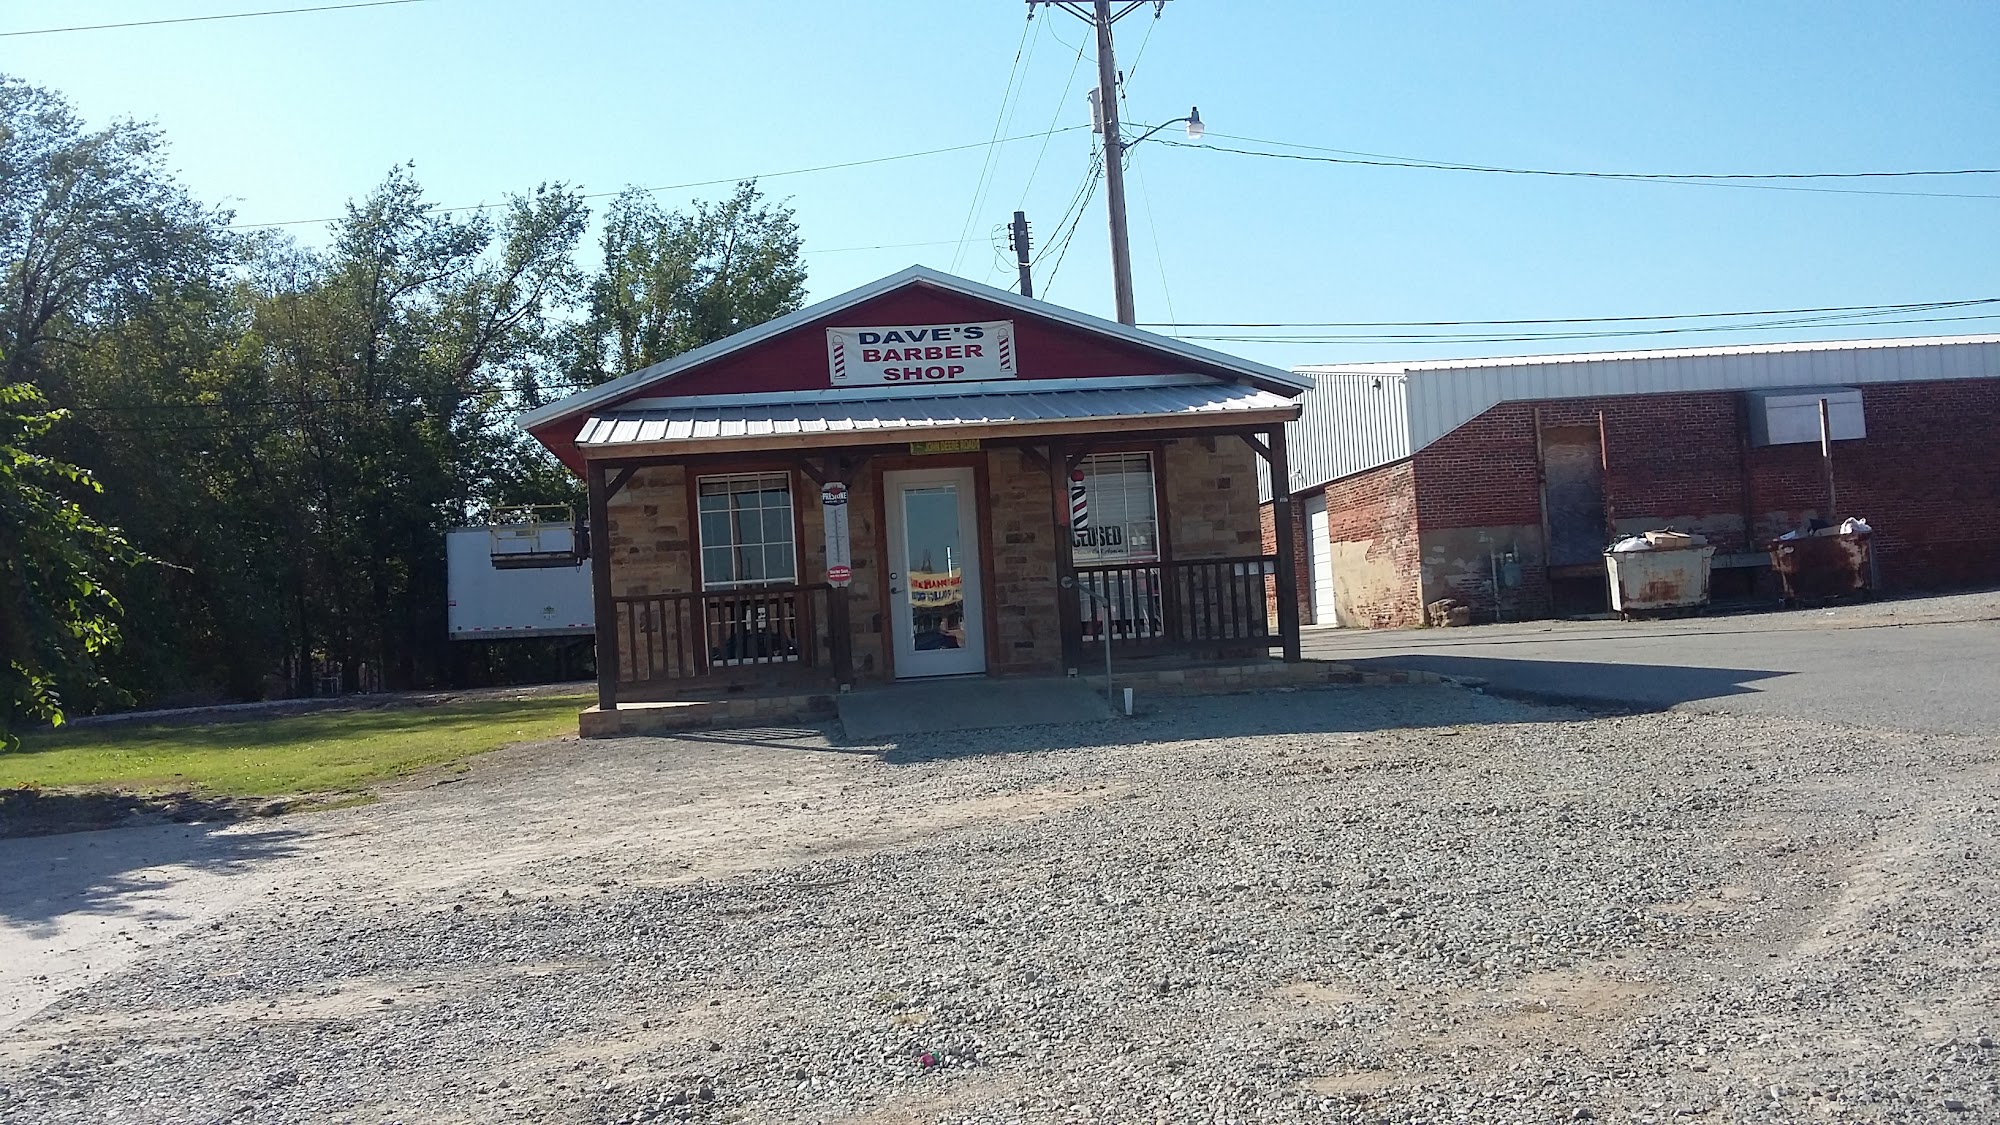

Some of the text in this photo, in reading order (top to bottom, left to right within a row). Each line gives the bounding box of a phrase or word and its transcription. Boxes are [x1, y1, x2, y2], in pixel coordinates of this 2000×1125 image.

[859, 326, 984, 345] DAVE'S
[863, 344, 984, 362] BARBER
[883, 365, 965, 381] SHOP
[940, 440, 960, 451] DEERE
[1073, 526, 1121, 547] CLOSED
